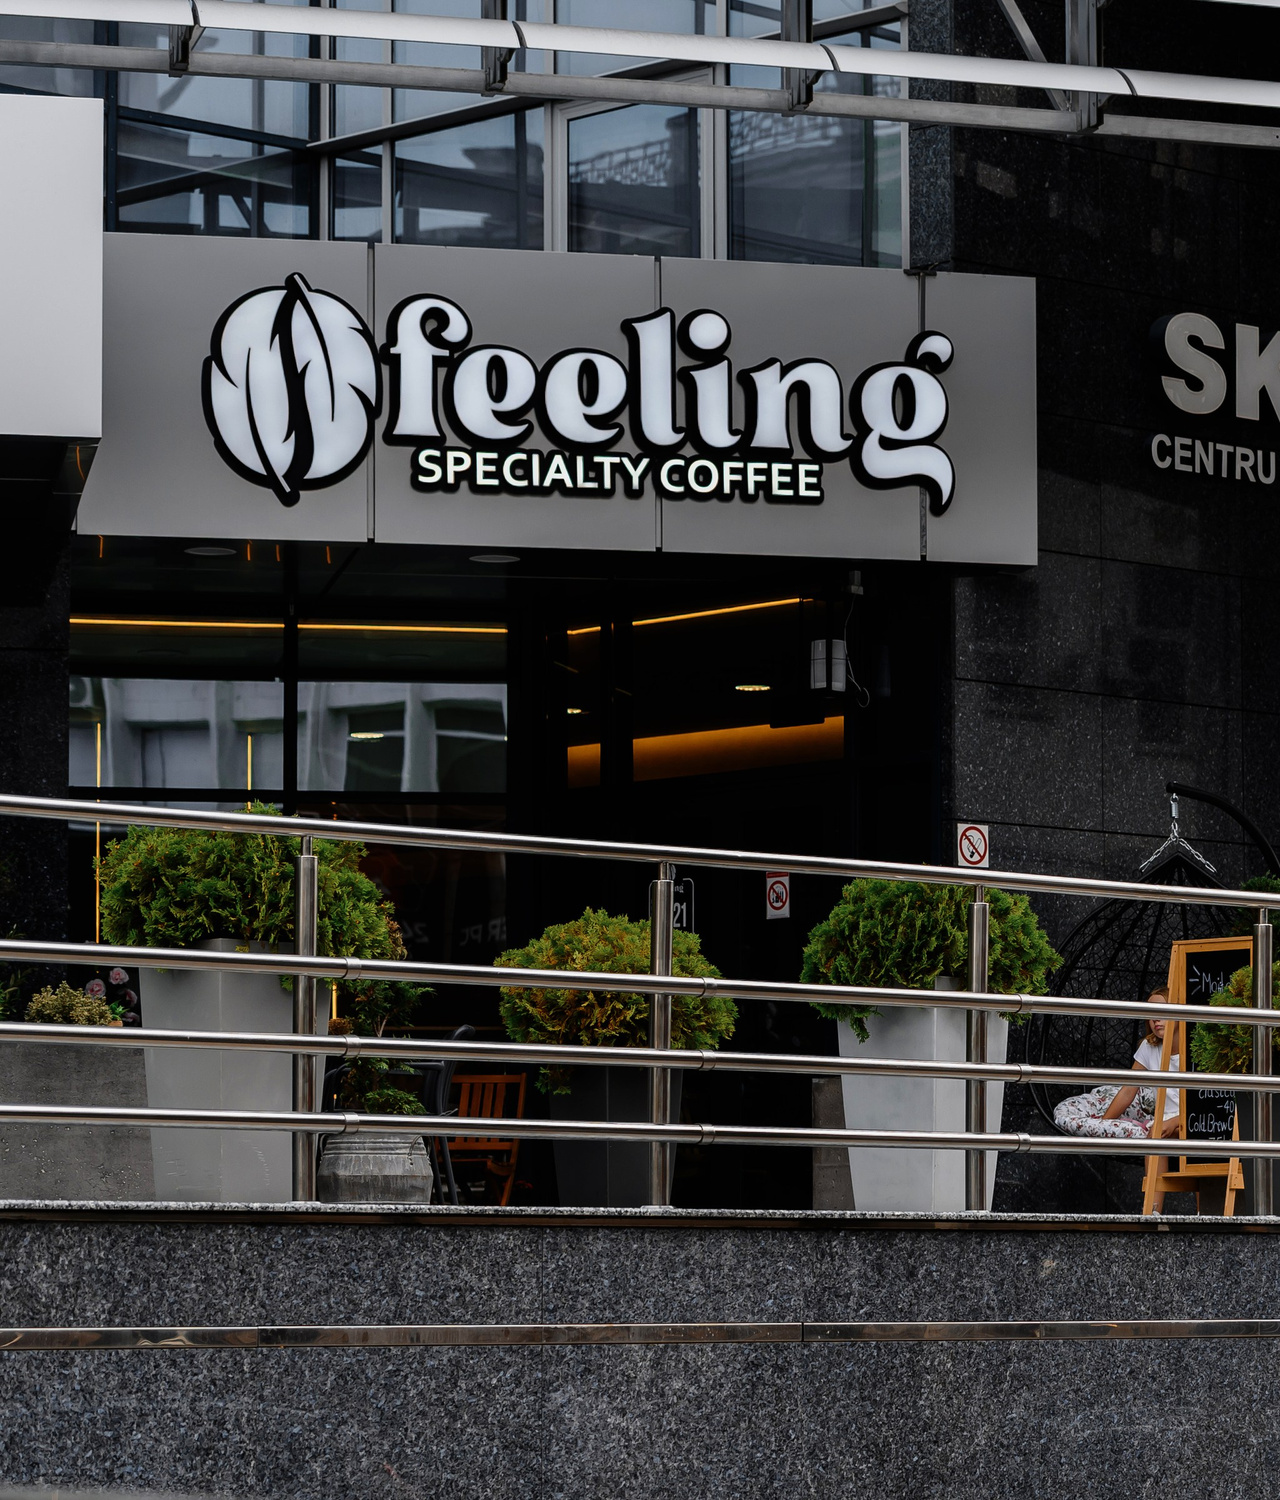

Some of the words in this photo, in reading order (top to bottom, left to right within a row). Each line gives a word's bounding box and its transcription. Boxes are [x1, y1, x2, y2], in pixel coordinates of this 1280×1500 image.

[389, 297, 955, 506] feeling
[416, 448, 651, 490] SPECIALTY
[659, 458, 822, 498] COFFEE
[1150, 433, 1277, 485] CENTRU
